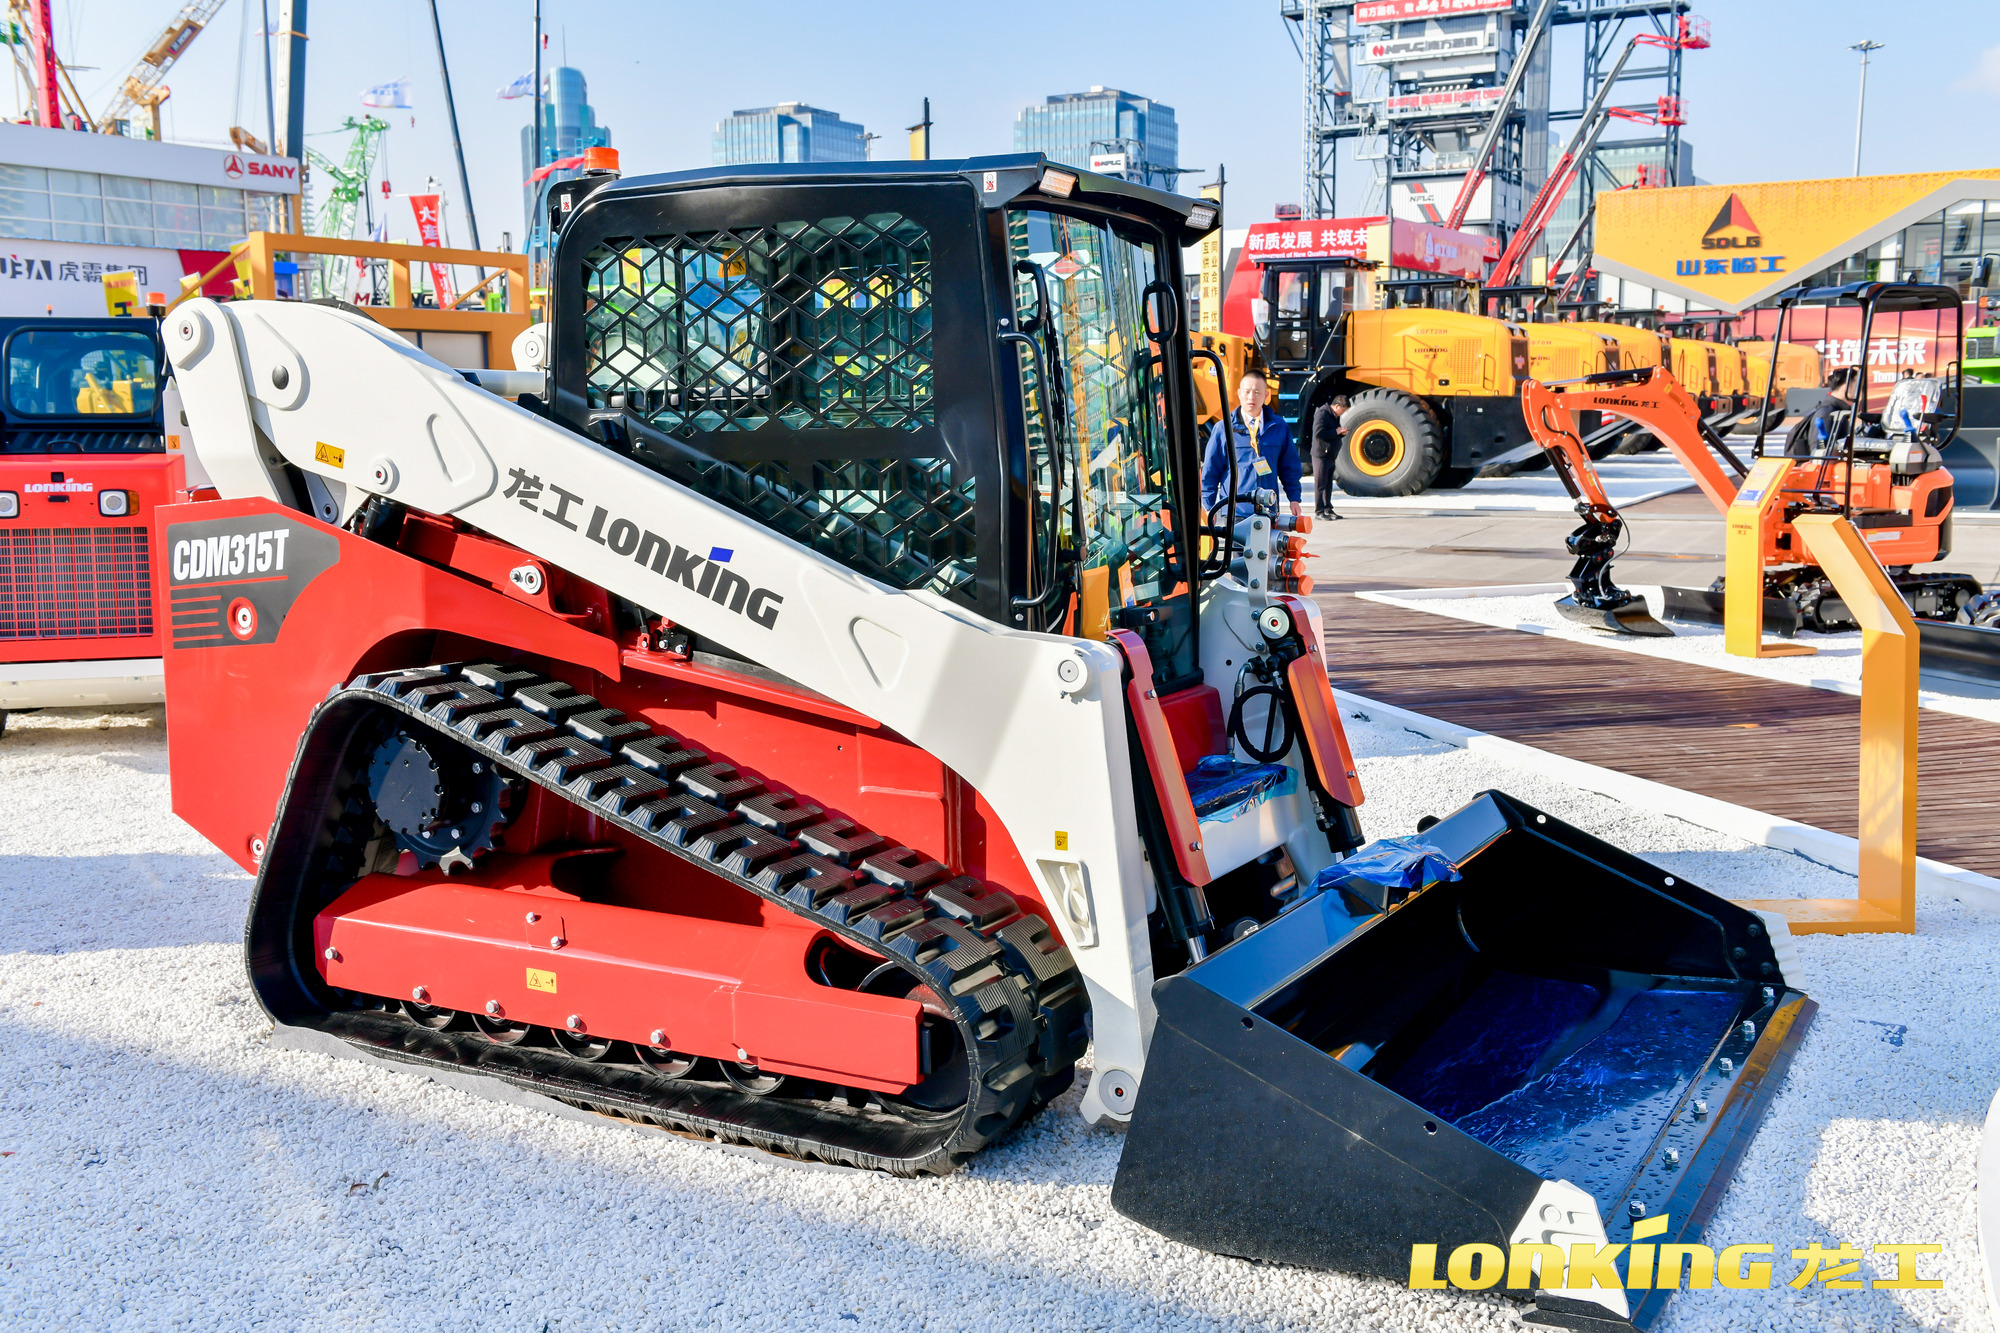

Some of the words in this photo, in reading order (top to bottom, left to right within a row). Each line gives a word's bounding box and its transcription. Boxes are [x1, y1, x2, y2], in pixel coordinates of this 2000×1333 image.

[248, 162, 296, 179] SANY
[1249, 231, 1312, 250] 新质发展
[1701, 236, 1761, 249] SDLG
[1676, 256, 1785, 276] 山东临工
[1593, 395, 1639, 407] LONKING
[24, 478, 94, 493] LONKING
[173, 529, 290, 581] CDM315T
[503, 467, 584, 532] 龙工
[585, 505, 784, 631] LONKING
